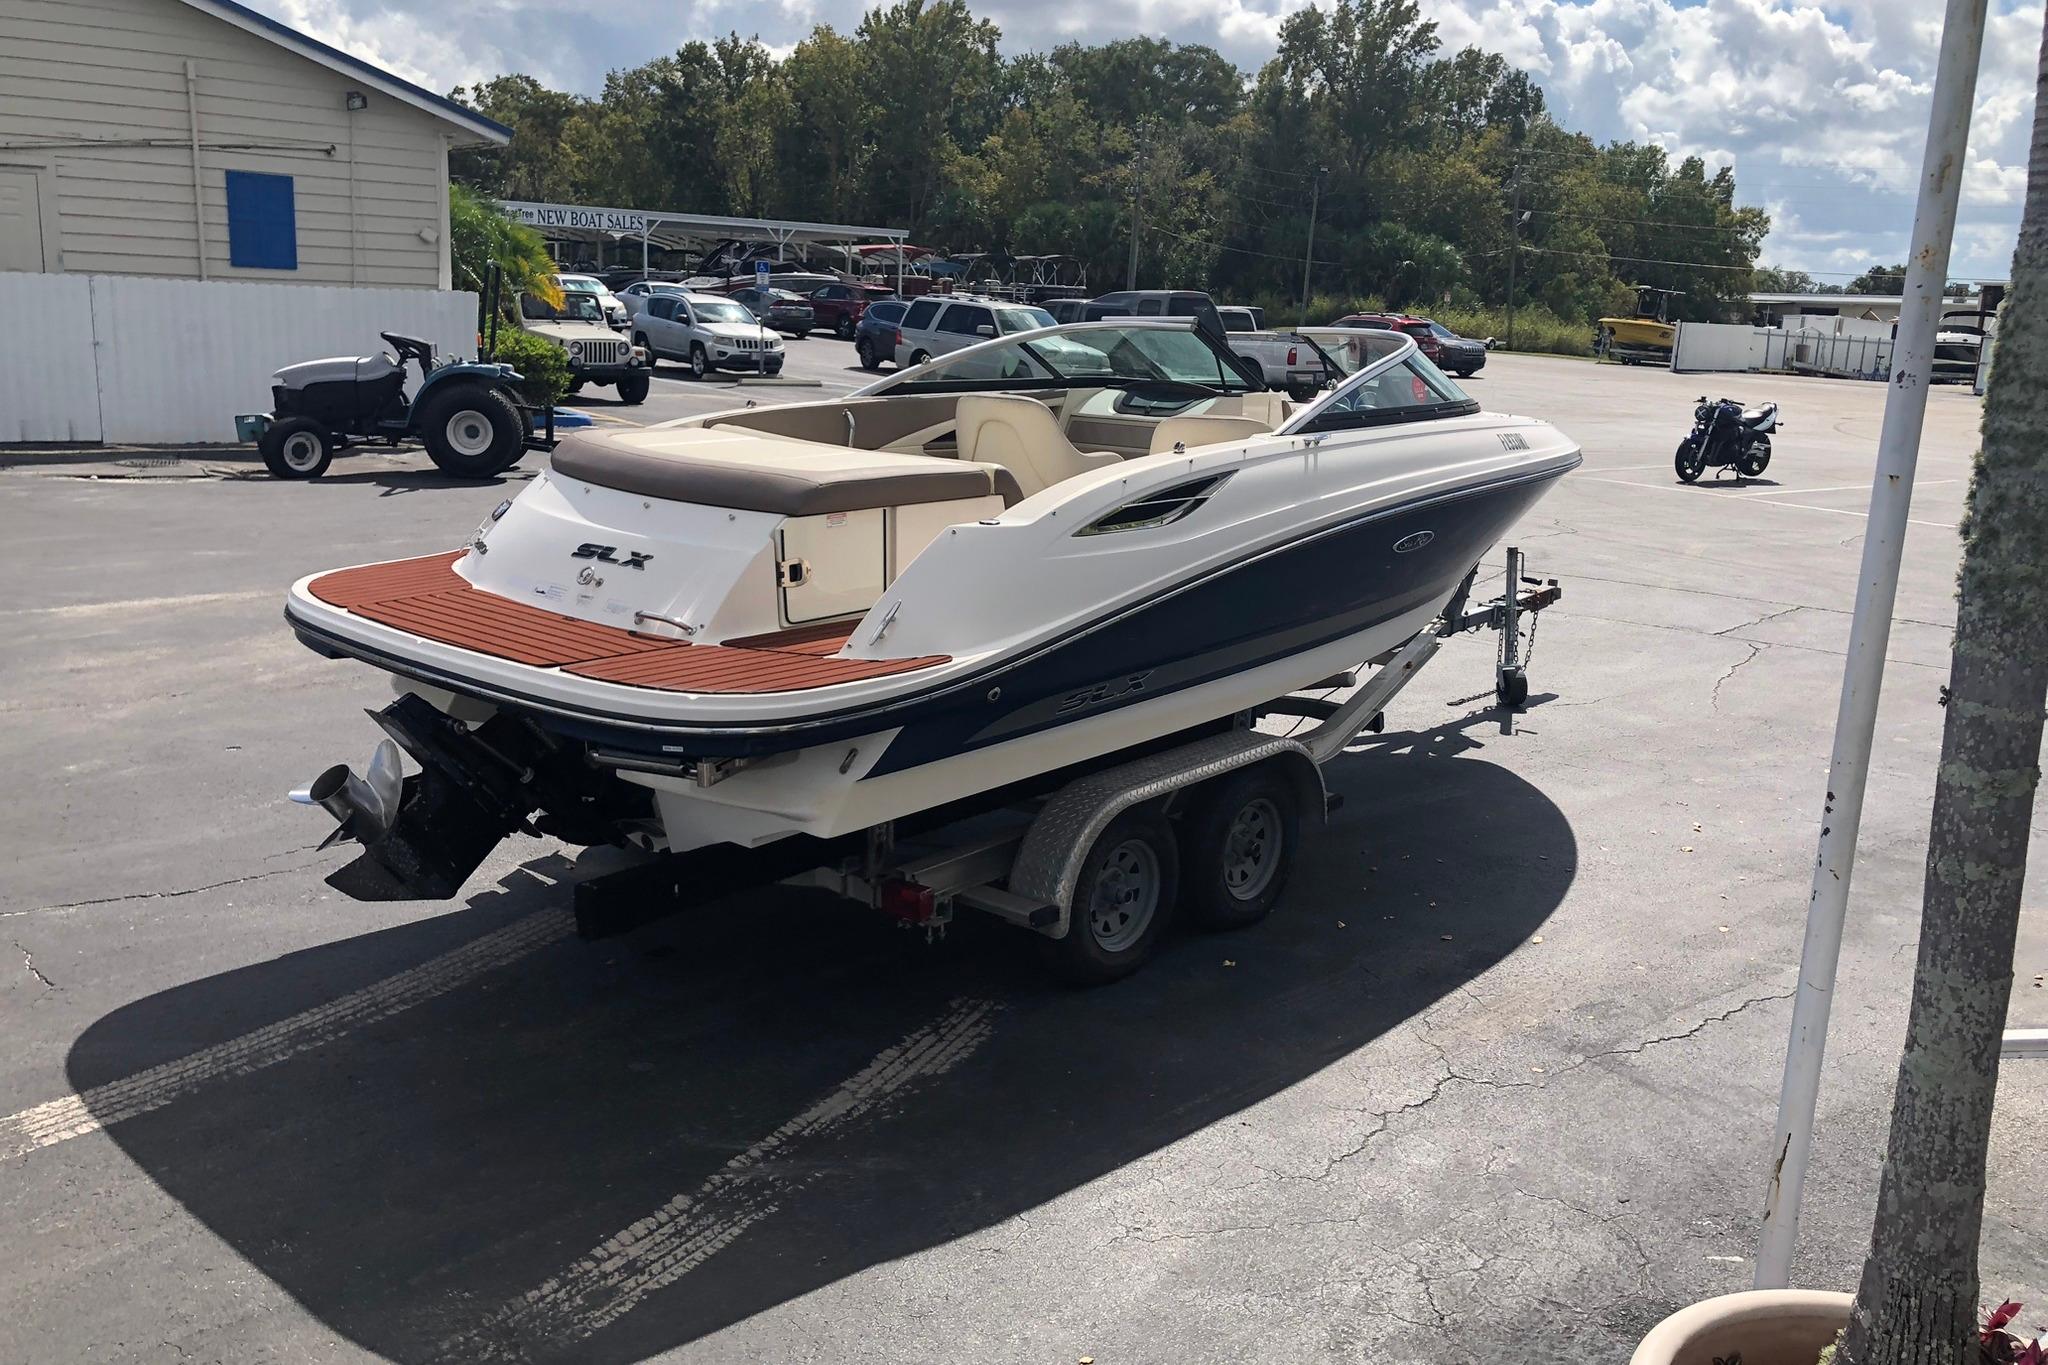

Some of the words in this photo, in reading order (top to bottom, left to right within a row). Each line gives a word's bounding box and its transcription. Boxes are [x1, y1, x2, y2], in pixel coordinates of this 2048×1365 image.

[537, 209, 568, 225] NEW
[570, 211, 604, 228] BOAT
[607, 215, 644, 231] SALES
[571, 542, 654, 571] SLX
[1056, 670, 1154, 715] SLX
